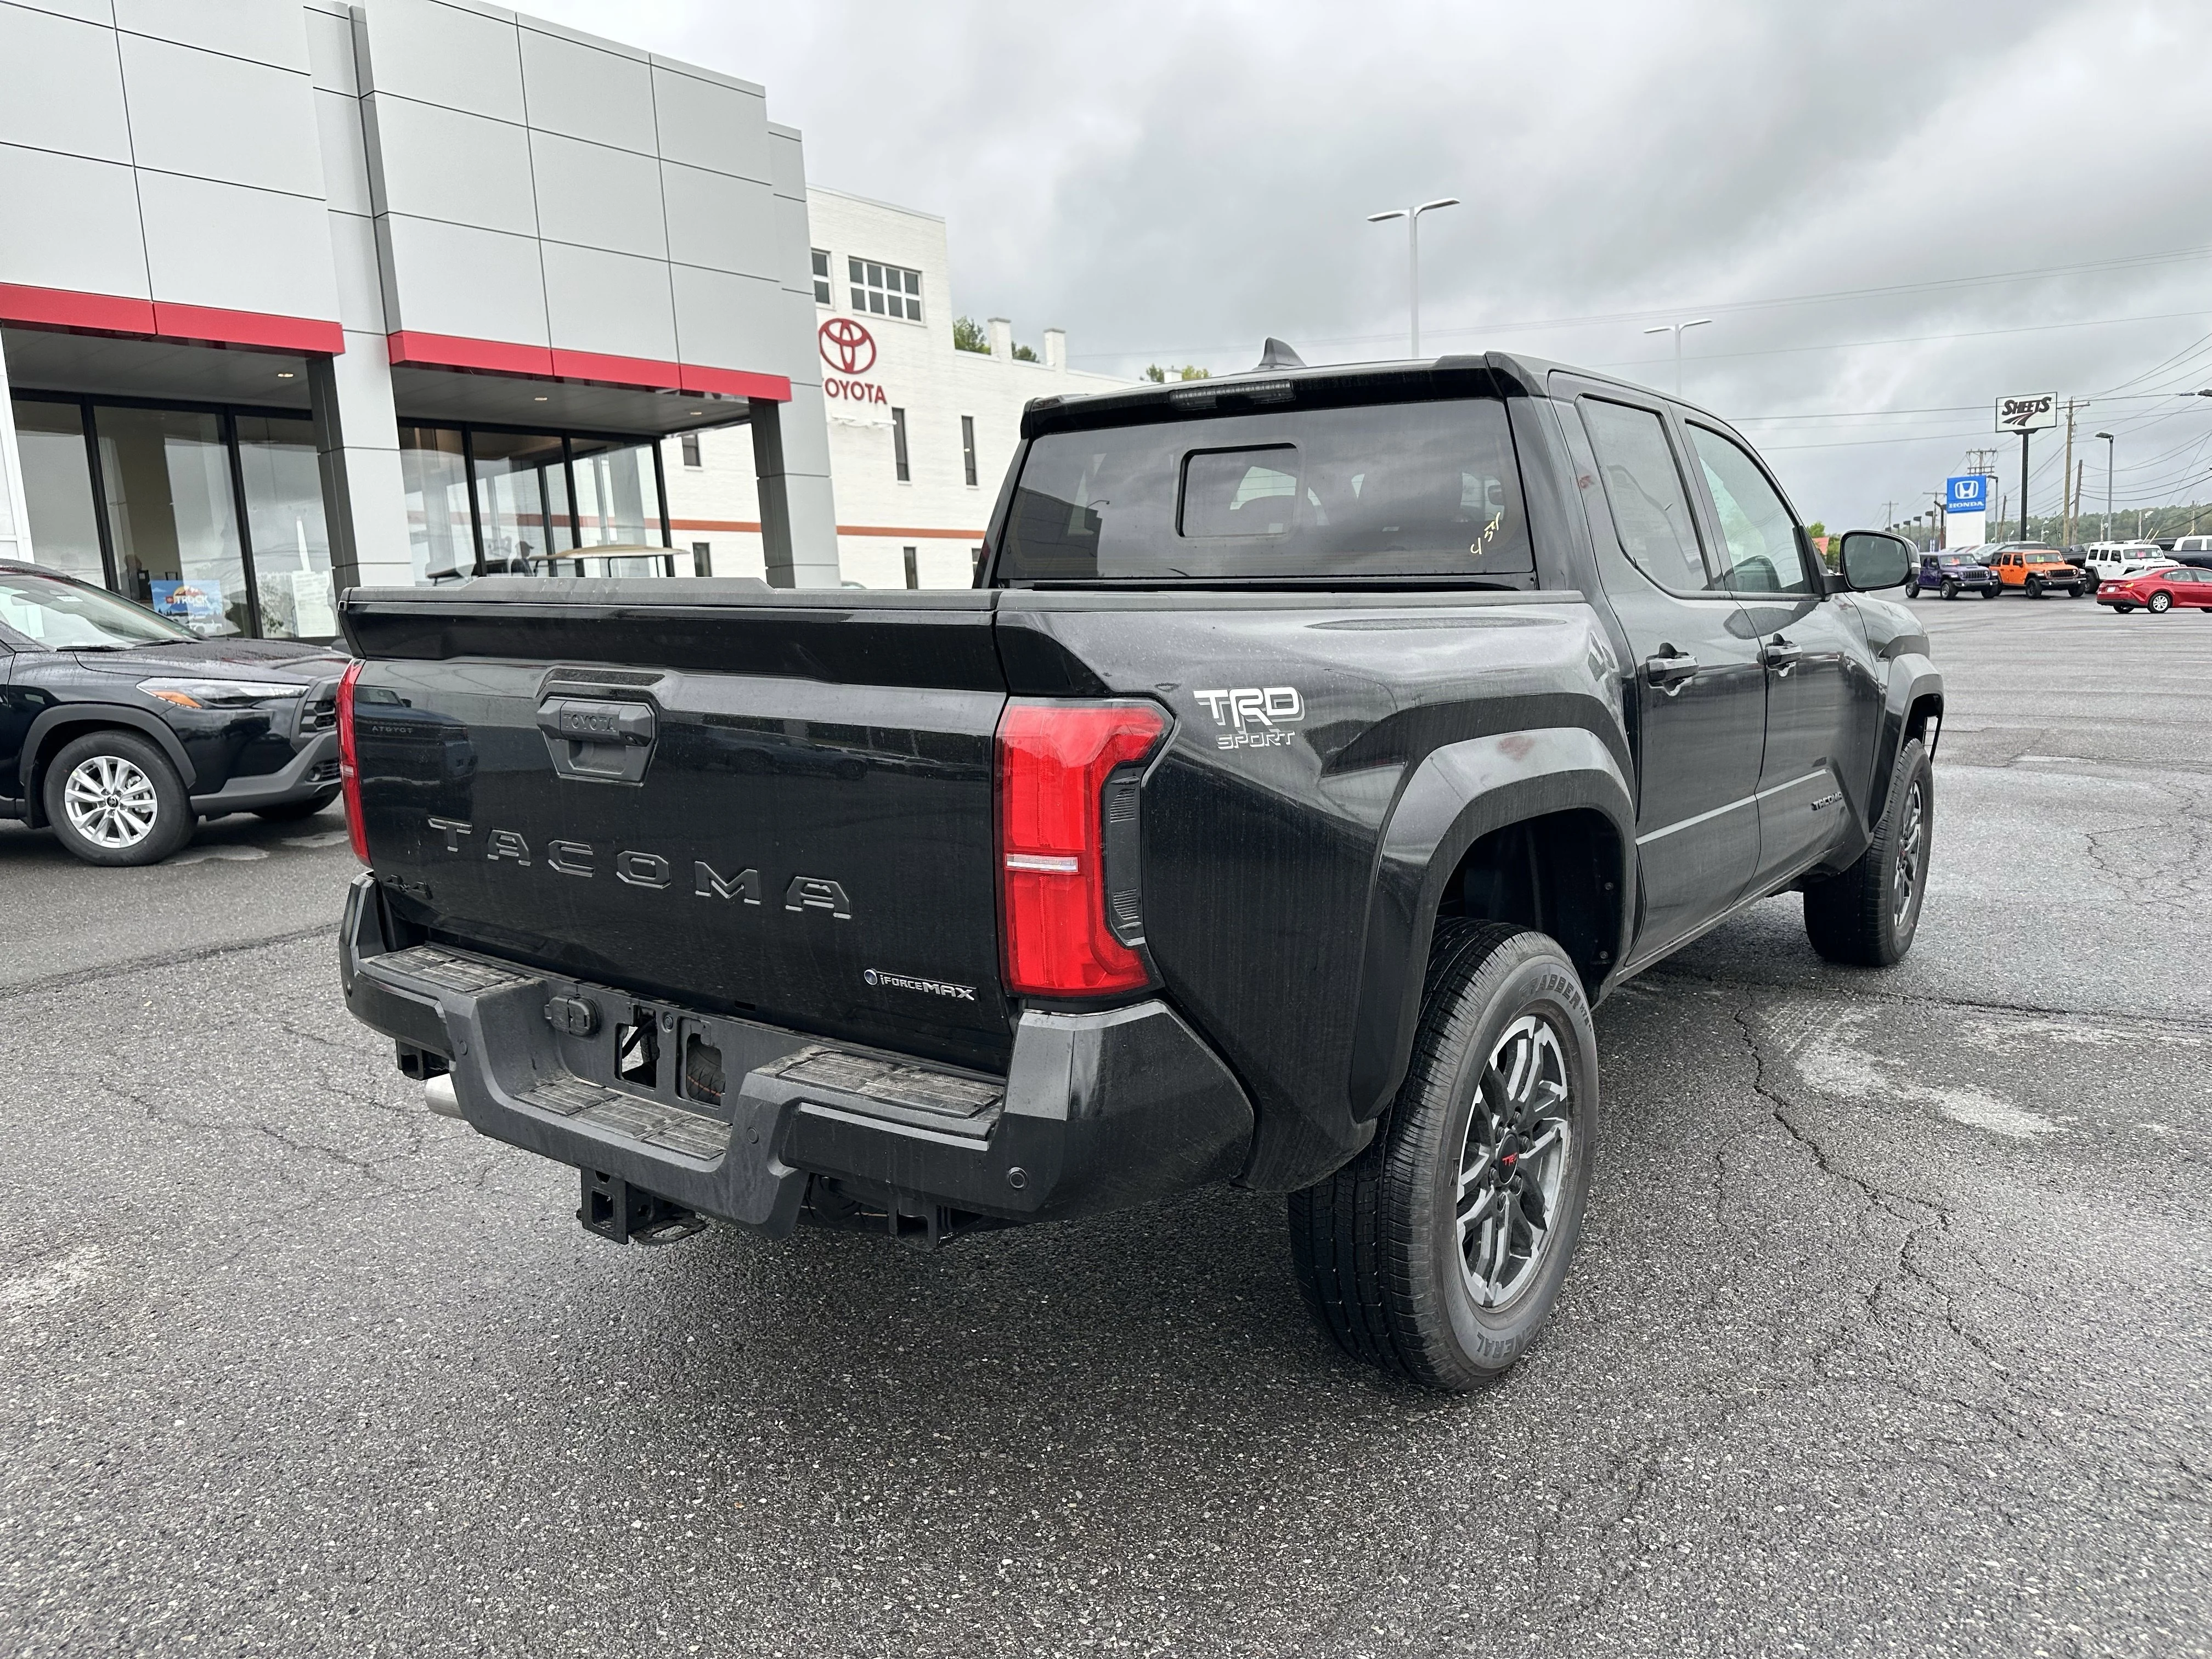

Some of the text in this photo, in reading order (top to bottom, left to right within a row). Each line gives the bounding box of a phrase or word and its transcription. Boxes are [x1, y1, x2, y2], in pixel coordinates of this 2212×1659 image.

[822, 377, 888, 404] OYOTA
[2001, 397, 2052, 415] SHEETS
[1948, 500, 1984, 509] HONDA
[1193, 686, 1304, 732] TRD
[563, 714, 617, 732] TOYOTA
[1216, 731, 1295, 749] SPORT
[1812, 792, 1842, 810] TACOMA
[428, 817, 851, 919] TACOMA
